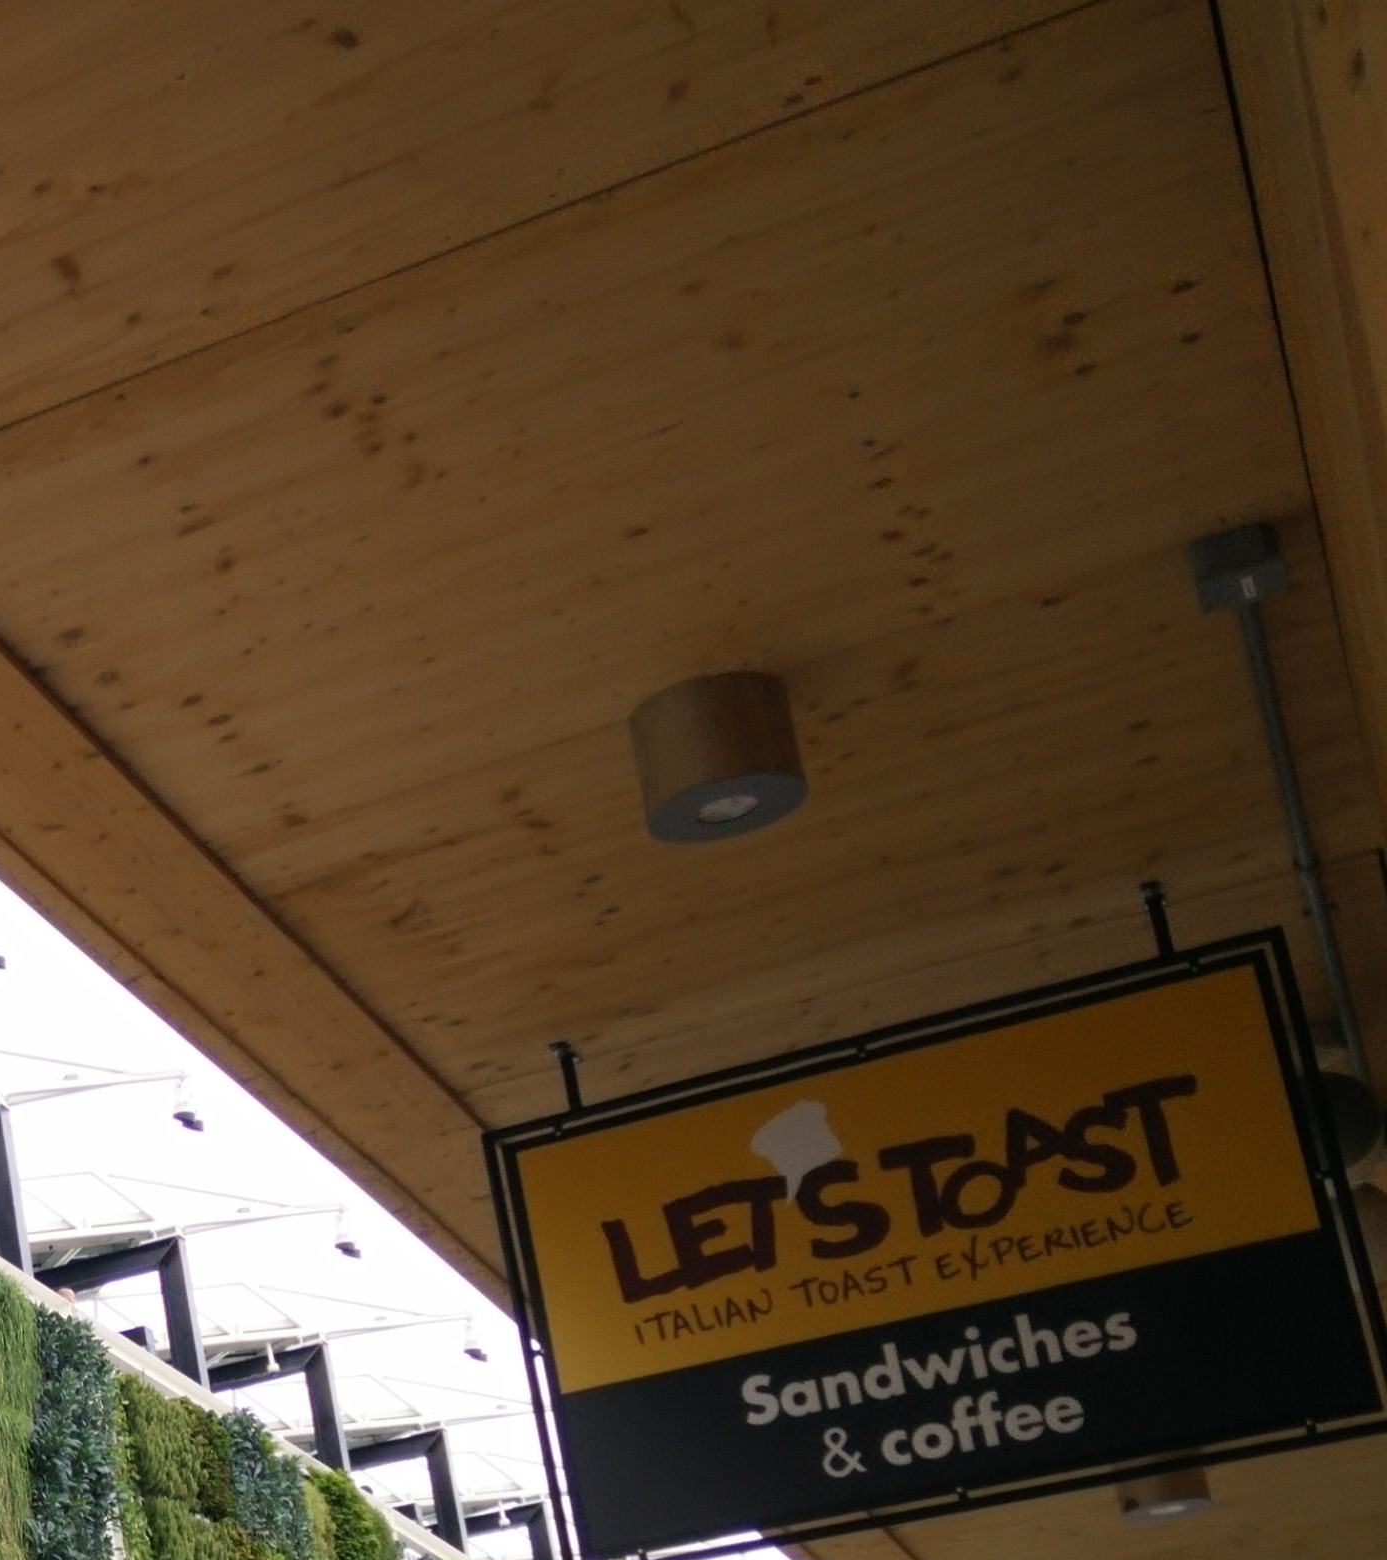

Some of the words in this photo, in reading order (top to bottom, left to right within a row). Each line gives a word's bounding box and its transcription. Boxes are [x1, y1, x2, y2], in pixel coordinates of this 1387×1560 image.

[878, 1075, 1197, 1238] TOAST
[634, 1288, 773, 1345] ITALIAN
[788, 1255, 918, 1307] TOAST
[935, 1202, 1193, 1281] EXPERIENCE
[741, 1312, 1138, 1426] Sandwiches
[822, 1427, 867, 1478] &
[881, 1391, 1085, 1466] coffee
